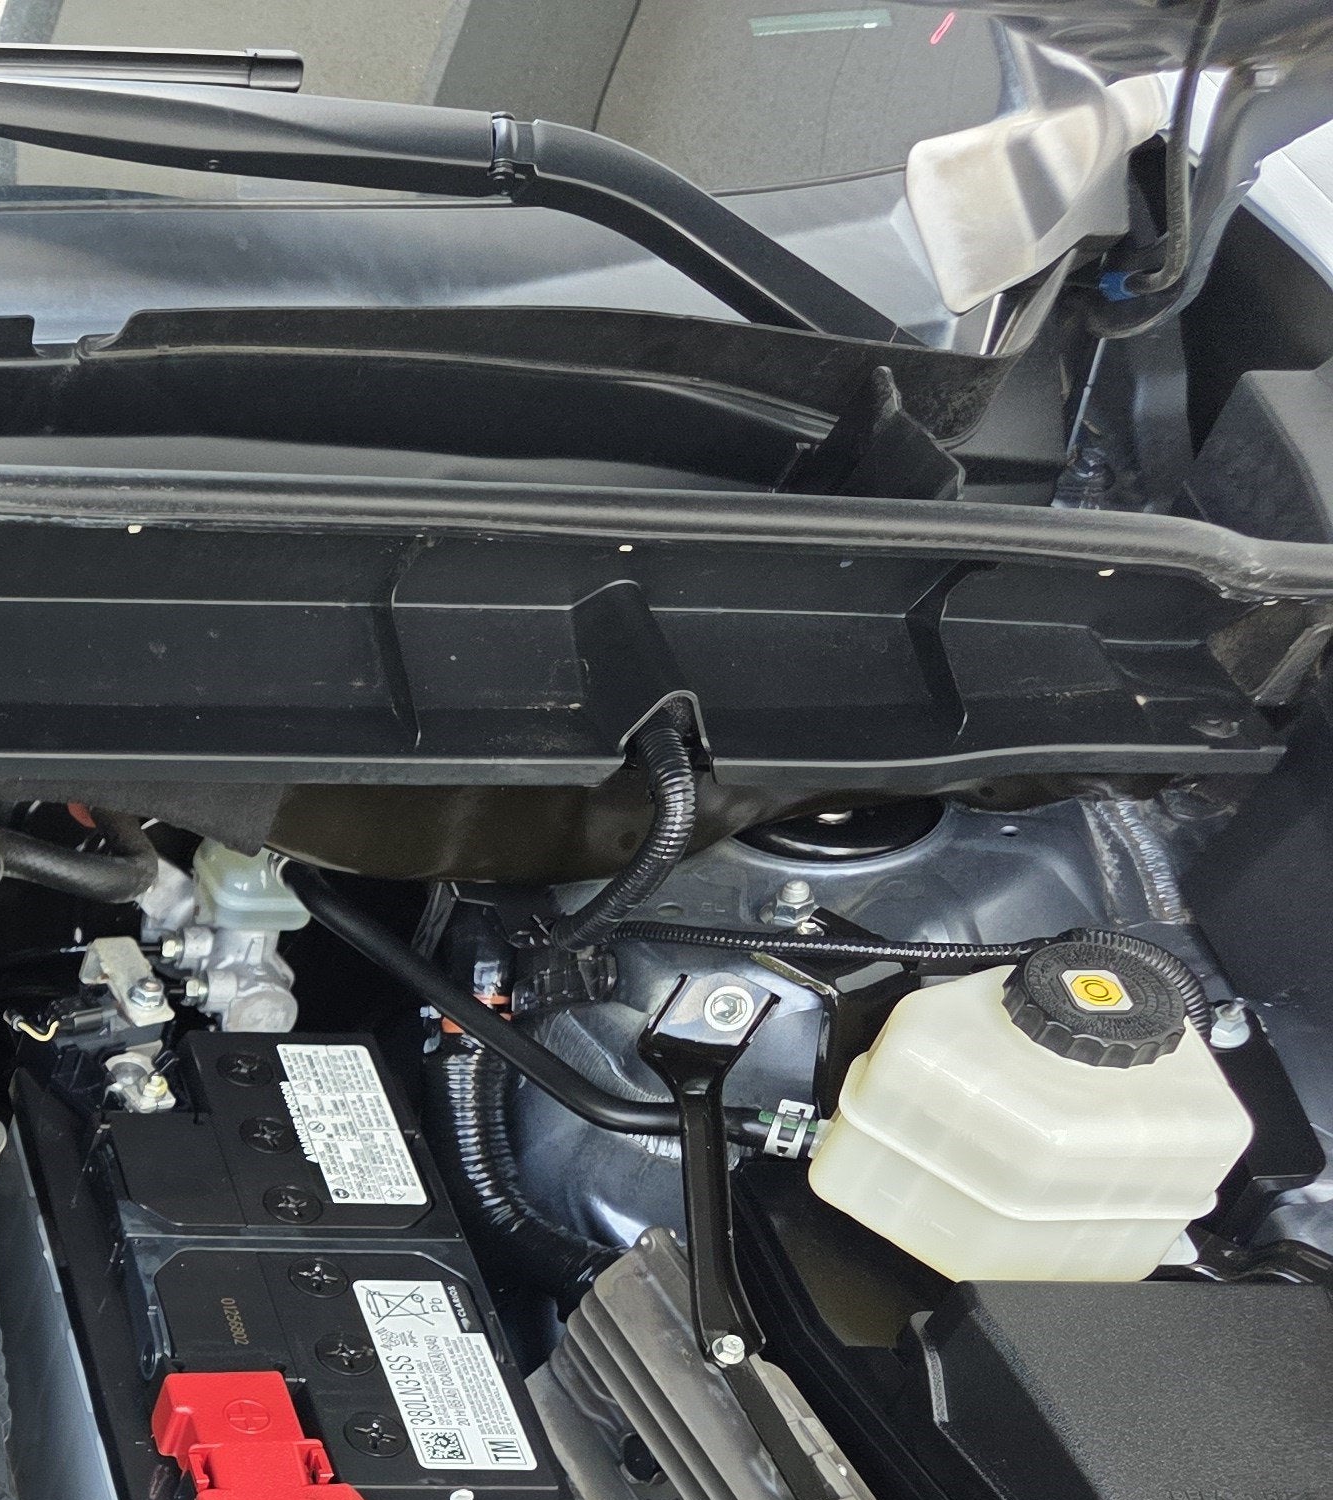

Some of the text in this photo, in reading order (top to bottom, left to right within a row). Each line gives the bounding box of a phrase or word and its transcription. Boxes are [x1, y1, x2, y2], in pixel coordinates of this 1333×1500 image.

[431, 1297, 446, 1313] Pb
[447, 1285, 467, 1318] CLARIOS
[386, 1355, 436, 1426] 380LN3-ISS
[488, 1440, 521, 1461] TM
